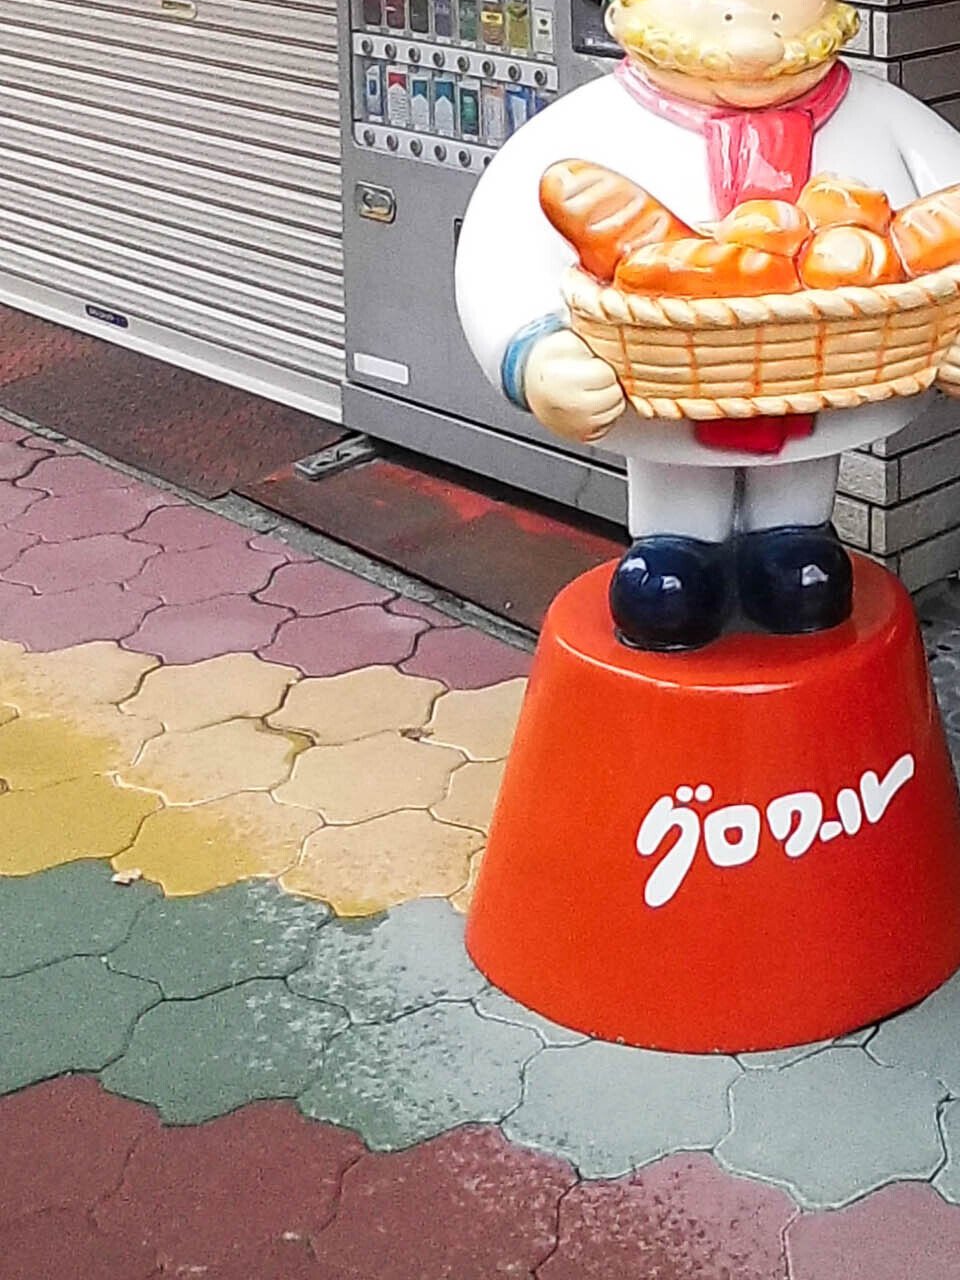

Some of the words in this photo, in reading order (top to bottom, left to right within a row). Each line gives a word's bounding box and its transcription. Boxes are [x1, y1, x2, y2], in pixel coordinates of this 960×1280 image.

[636, 753, 915, 907] グロワール
